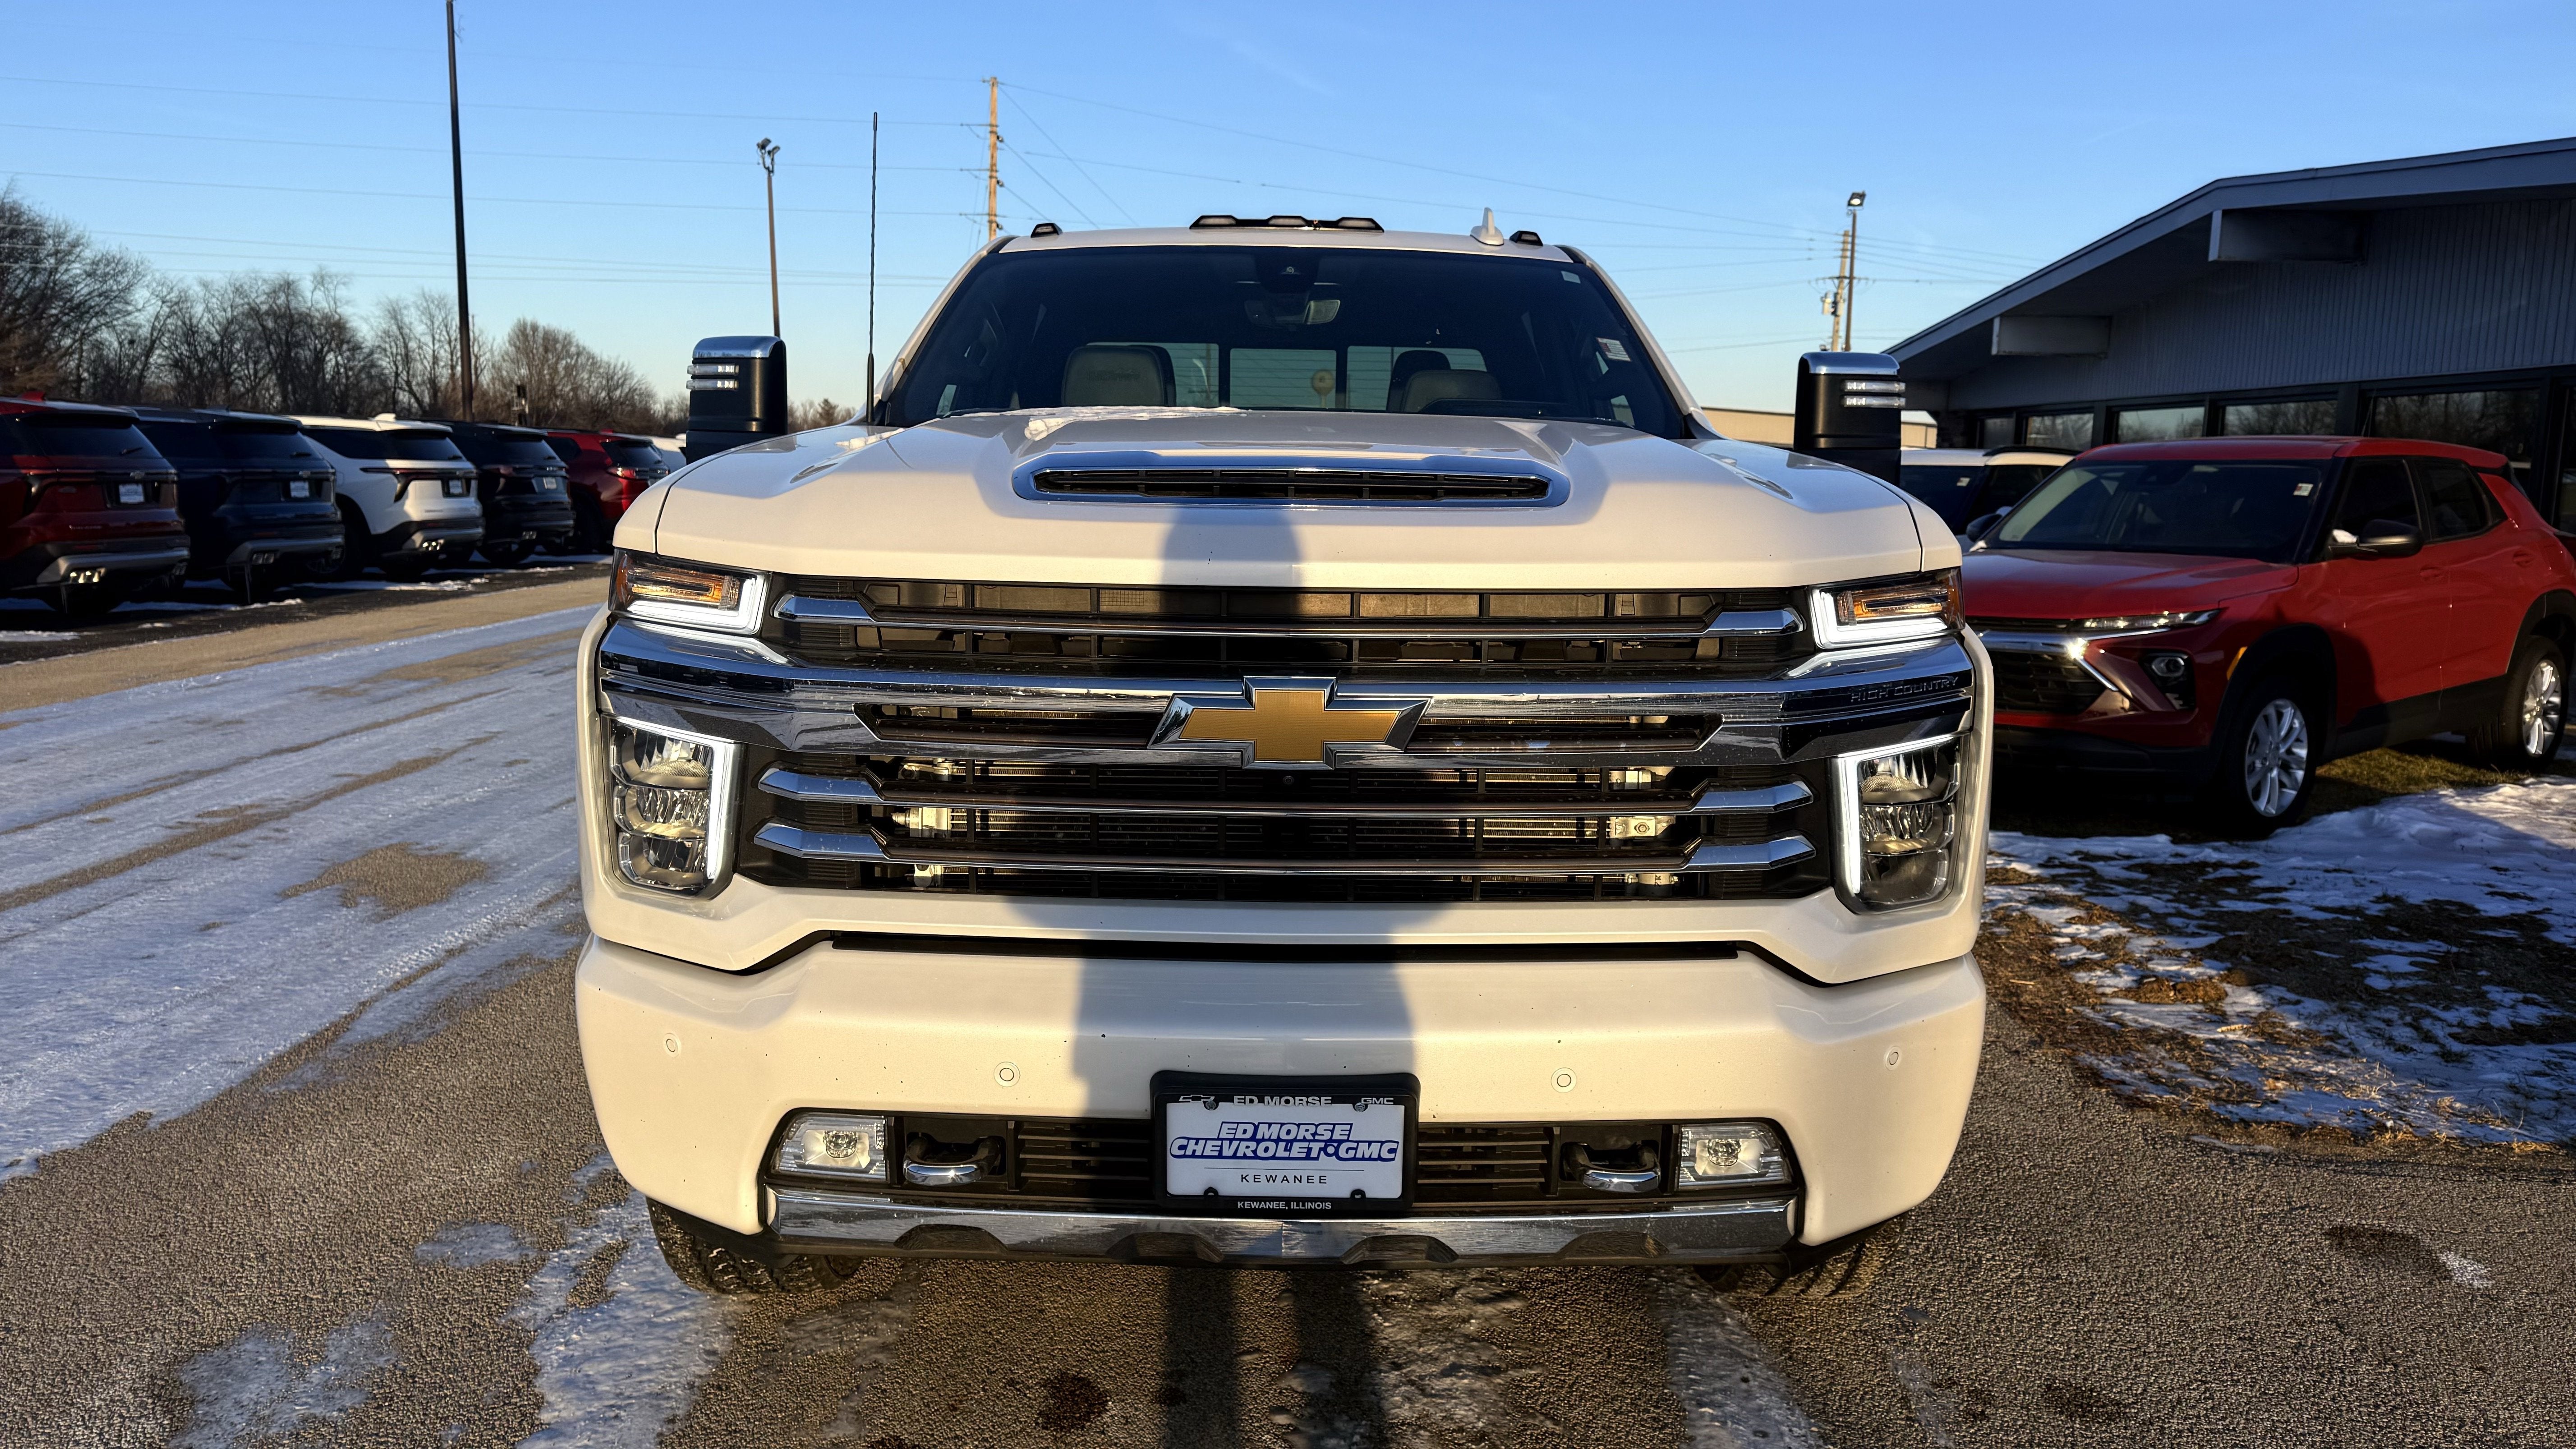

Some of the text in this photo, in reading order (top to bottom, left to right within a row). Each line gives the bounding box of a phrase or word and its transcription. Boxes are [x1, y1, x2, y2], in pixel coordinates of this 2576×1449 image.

[1850, 676, 1959, 702] HIGH COUNTRY
[1233, 1095, 1332, 1107] ED MORSE
[1218, 1122, 1351, 1140] ED MORSE
[1241, 1174, 1327, 1184] KEWANEE
[1237, 1201, 1332, 1210] KEWANEE, ILLINOIS
